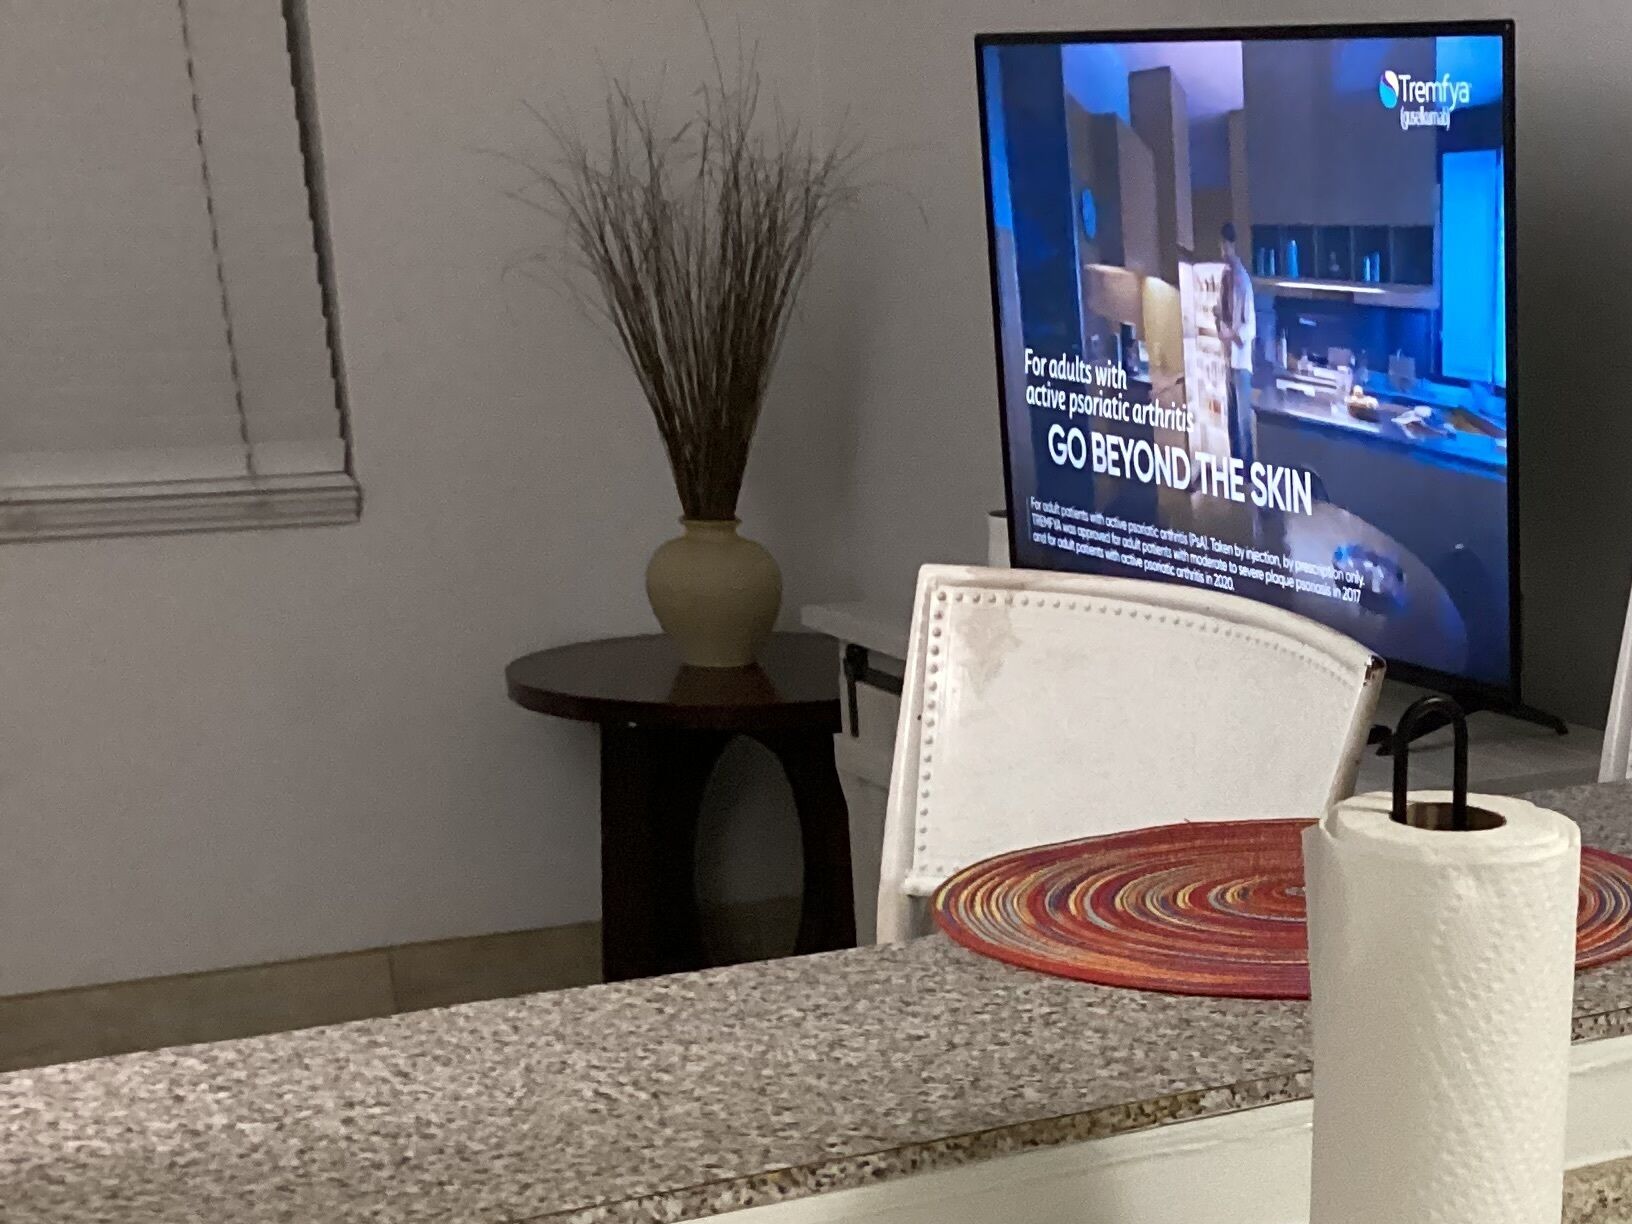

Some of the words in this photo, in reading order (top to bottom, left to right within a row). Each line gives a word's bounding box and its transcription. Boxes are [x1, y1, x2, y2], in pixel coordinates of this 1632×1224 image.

[1398, 73, 1470, 111] Tremfya
[1024, 348, 1047, 376] For
[1049, 352, 1092, 385] adults
[1095, 359, 1127, 390] with
[1025, 382, 1066, 409] active
[1069, 389, 1130, 421] psoriatic
[1132, 397, 1194, 433] arthritis
[1048, 423, 1087, 469] GO
[1091, 430, 1191, 490] BEYOND
[1195, 451, 1245, 503] THE
[1250, 462, 1312, 516] SKIN
[1030, 496, 1042, 511] For
[1042, 500, 1060, 515] adult
[1061, 505, 1089, 522] patients
[1089, 511, 1105, 526] with
[1105, 516, 1127, 531] active
[1128, 521, 1159, 538] psoriatic
[1160, 528, 1189, 546] arthritis
[1210, 537, 1233, 553] Taken
[1234, 543, 1245, 561] by
[1245, 547, 1282, 568] injection,
[1283, 553, 1294, 573] by
[1294, 560, 1344, 581] prescription
[1345, 569, 1365, 588] only.
[1032, 531, 1047, 544] and
[1047, 532, 1056, 546] for
[1057, 535, 1075, 551] adult
[1076, 541, 1104, 559] patients
[1105, 549, 1120, 563] with
[1121, 552, 1143, 568] active
[1144, 558, 1175, 576] psoriatic
[1176, 566, 1204, 584] arthritis
[1205, 571, 1213, 585] in
[1062, 523, 1077, 536] was
[1077, 526, 1110, 544] approved
[1111, 532, 1122, 546] for
[1122, 536, 1141, 551] adult
[1142, 542, 1172, 559] patients
[1173, 549, 1189, 563] with
[1190, 553, 1227, 571] moderate
[1229, 561, 1238, 574] to
[1239, 565, 1264, 580] severe
[1265, 569, 1294, 589] plaque
[1332, 585, 1342, 599] in
[1342, 587, 1361, 603] 2017
